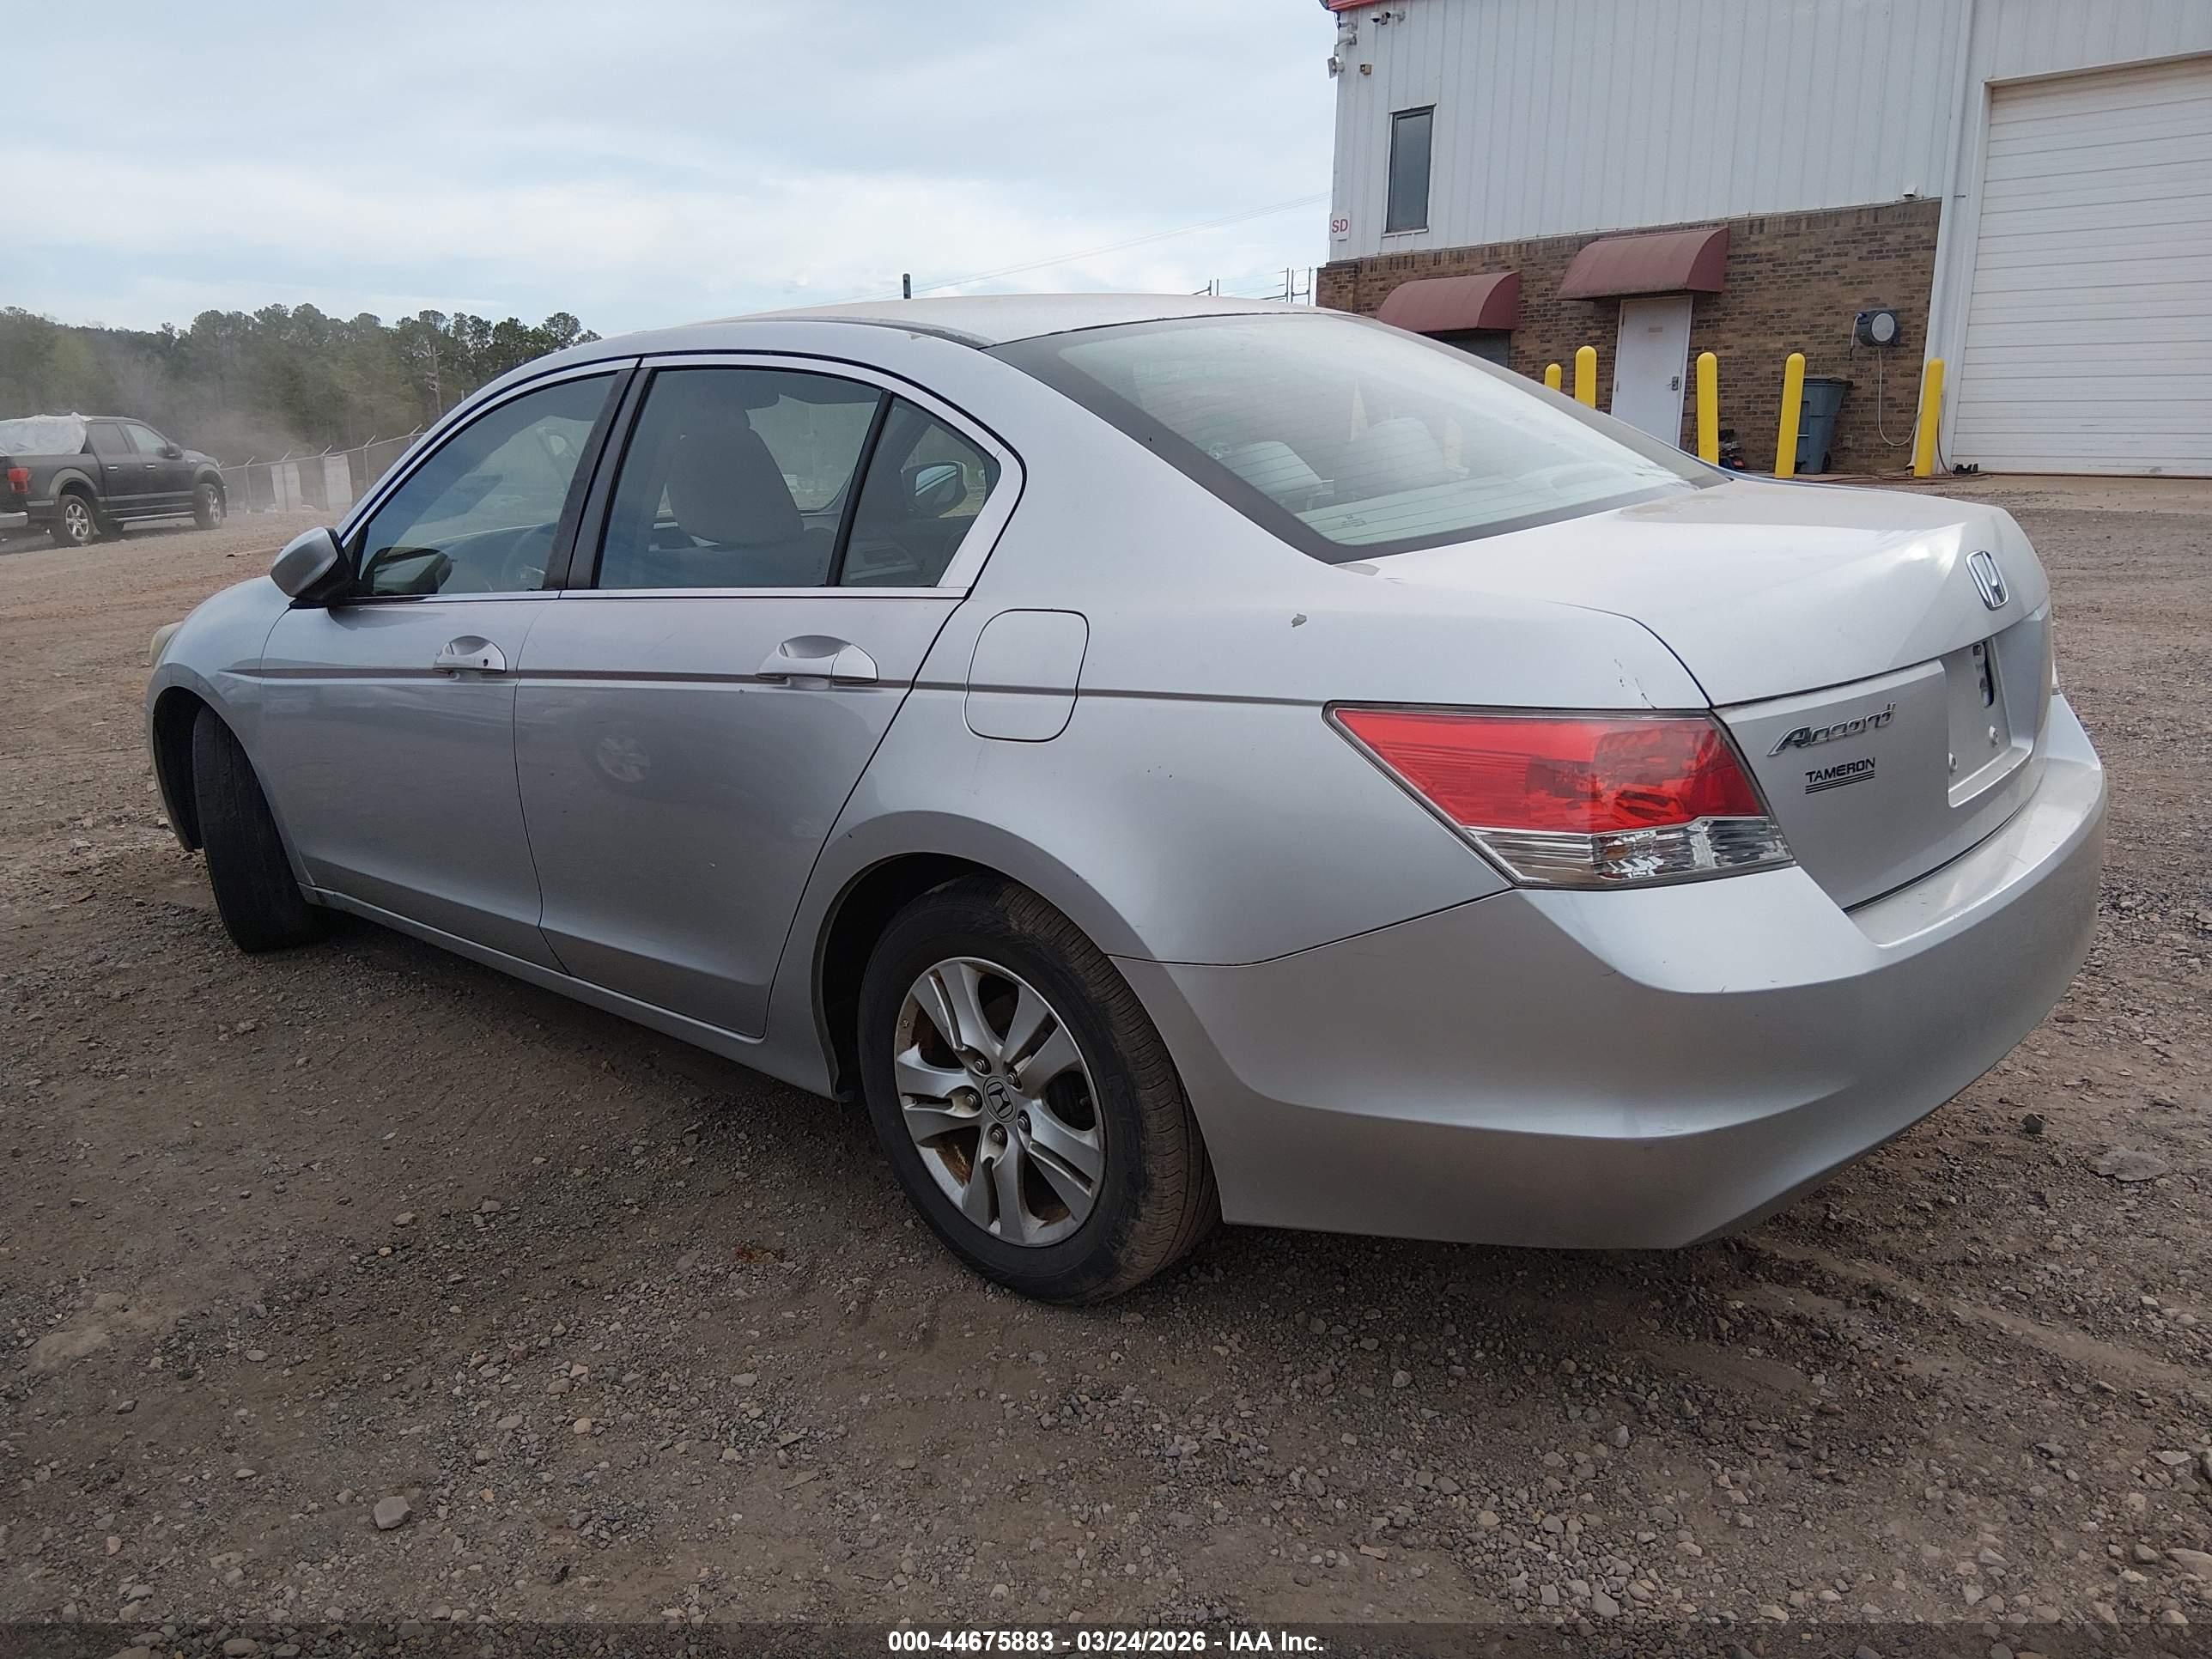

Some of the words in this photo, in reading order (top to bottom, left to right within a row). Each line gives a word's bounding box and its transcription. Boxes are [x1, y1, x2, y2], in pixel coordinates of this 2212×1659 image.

[1331, 218, 1349, 234] SD
[1766, 702, 1896, 757] Accord
[1805, 757, 1875, 783] TAMERON
